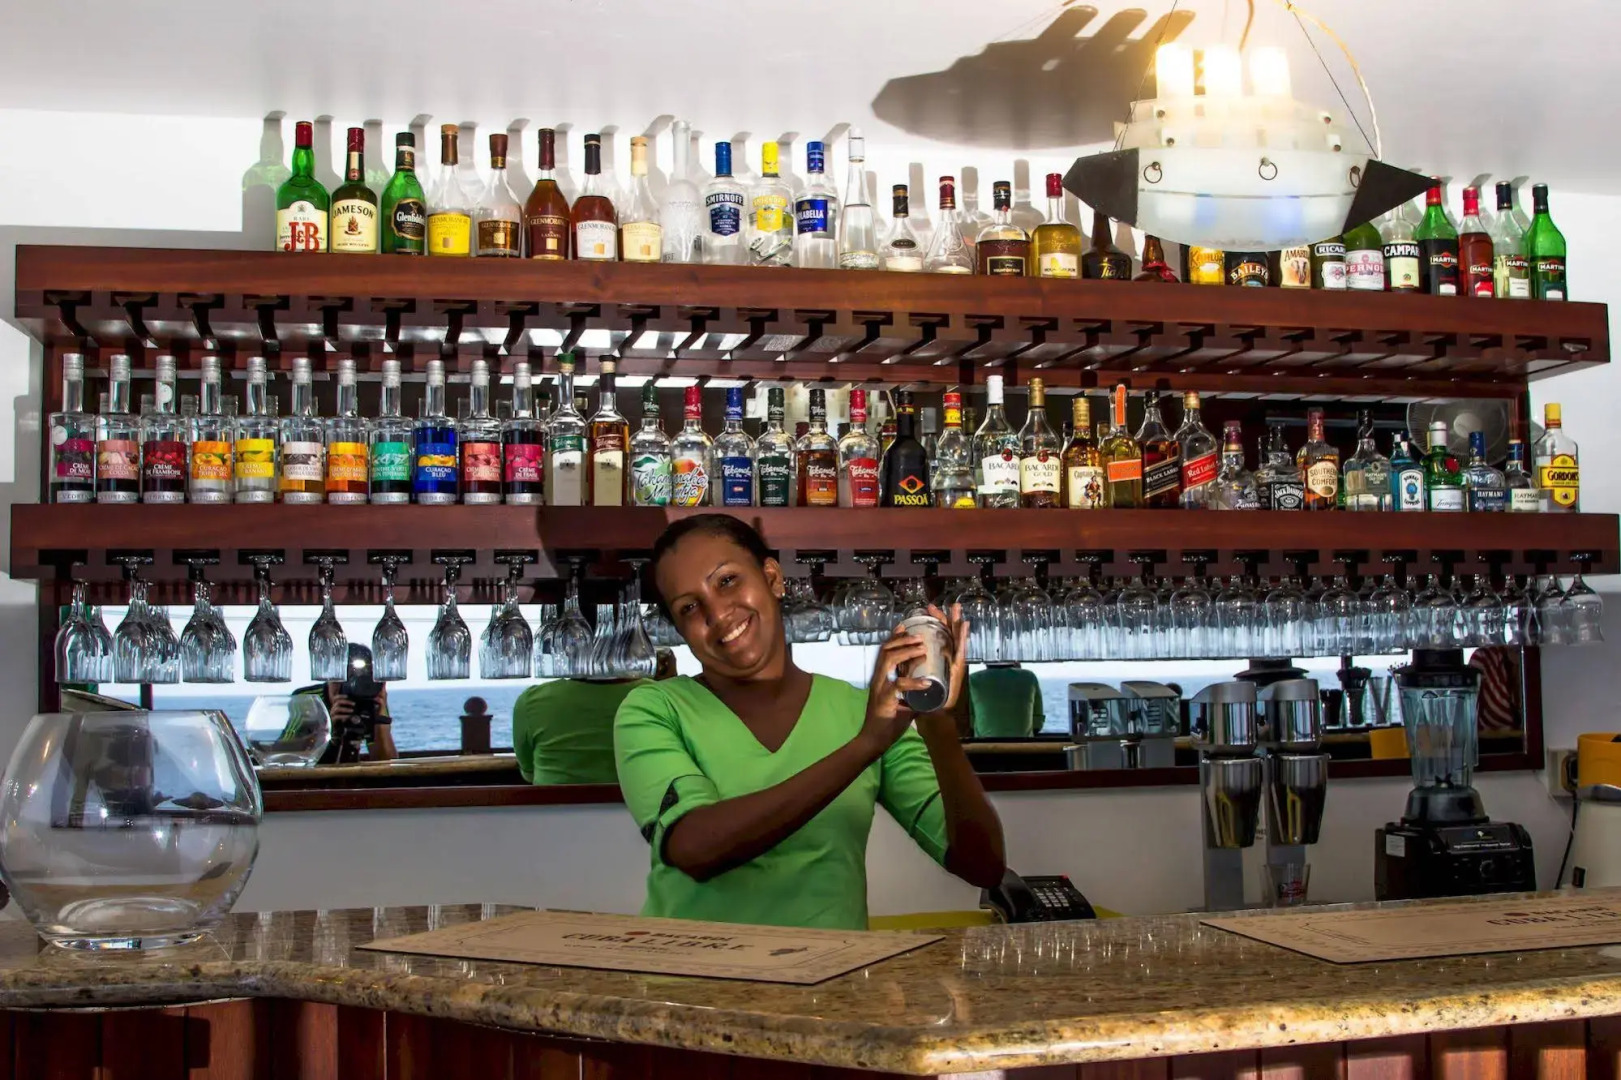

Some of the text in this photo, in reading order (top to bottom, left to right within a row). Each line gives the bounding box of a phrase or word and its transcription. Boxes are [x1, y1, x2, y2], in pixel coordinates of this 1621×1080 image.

[706, 194, 744, 206] SMIRNOFF
[334, 204, 374, 219] JAMESON
[284, 221, 321, 251] J&B
[1318, 245, 1346, 255] RICAR
[1230, 264, 1269, 281] BAILEYS
[988, 461, 1020, 471] BACARD
[1145, 472, 1164, 484] BLACK
[1187, 468, 1201, 478] Red
[1274, 488, 1287, 500] JACK
